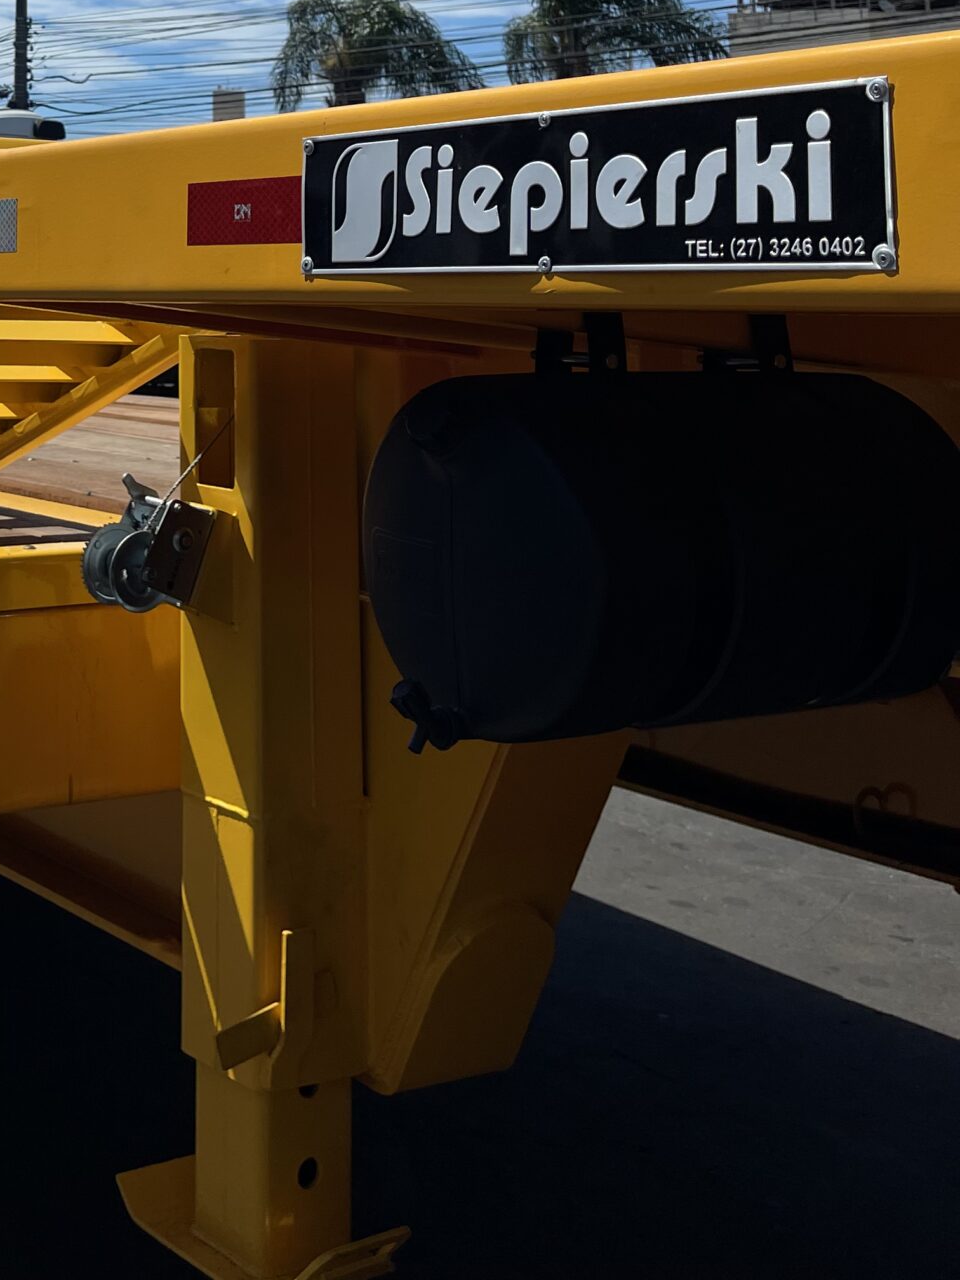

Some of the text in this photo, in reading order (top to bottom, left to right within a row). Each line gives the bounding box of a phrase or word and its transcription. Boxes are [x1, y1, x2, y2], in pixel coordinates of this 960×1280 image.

[401, 108, 833, 257] Siepierski
[684, 235, 867, 261] TEL: (27) 3246 0402
